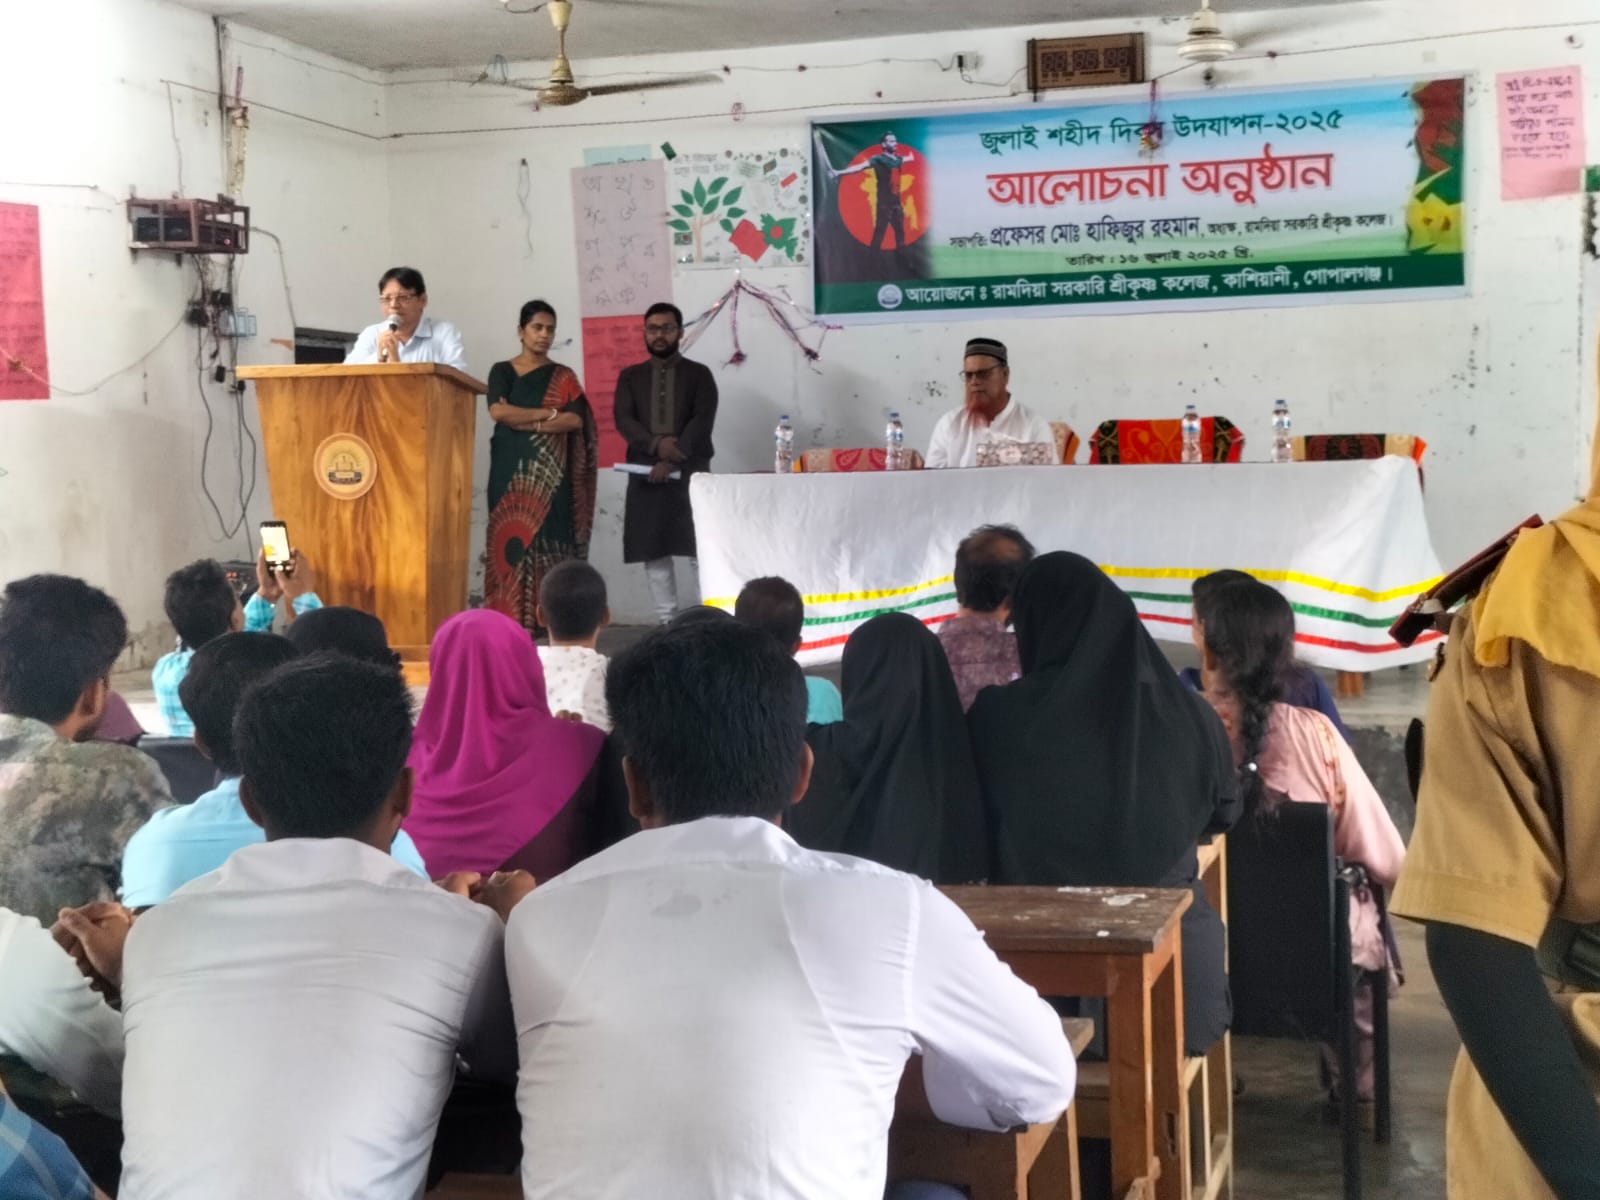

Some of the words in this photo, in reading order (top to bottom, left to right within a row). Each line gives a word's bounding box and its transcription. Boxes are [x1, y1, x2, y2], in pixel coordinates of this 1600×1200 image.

[980, 123, 1039, 155] জুলাই
[1046, 119, 1103, 147] শহীদ
[1172, 109, 1344, 138] উদযাপন-২০২৫
[986, 163, 1169, 206] আলোচনা
[1180, 142, 1334, 204] অনুষ্ঠান
[990, 225, 1046, 247] প্রফেসর
[1085, 214, 1146, 245] হাফিজুর
[905, 285, 976, 303] আয়োজনে
[991, 278, 1048, 299] রামদিয়া
[1050, 275, 1106, 296] সরকারি
[1109, 273, 1157, 300] শ্রীকৃষ্ণ
